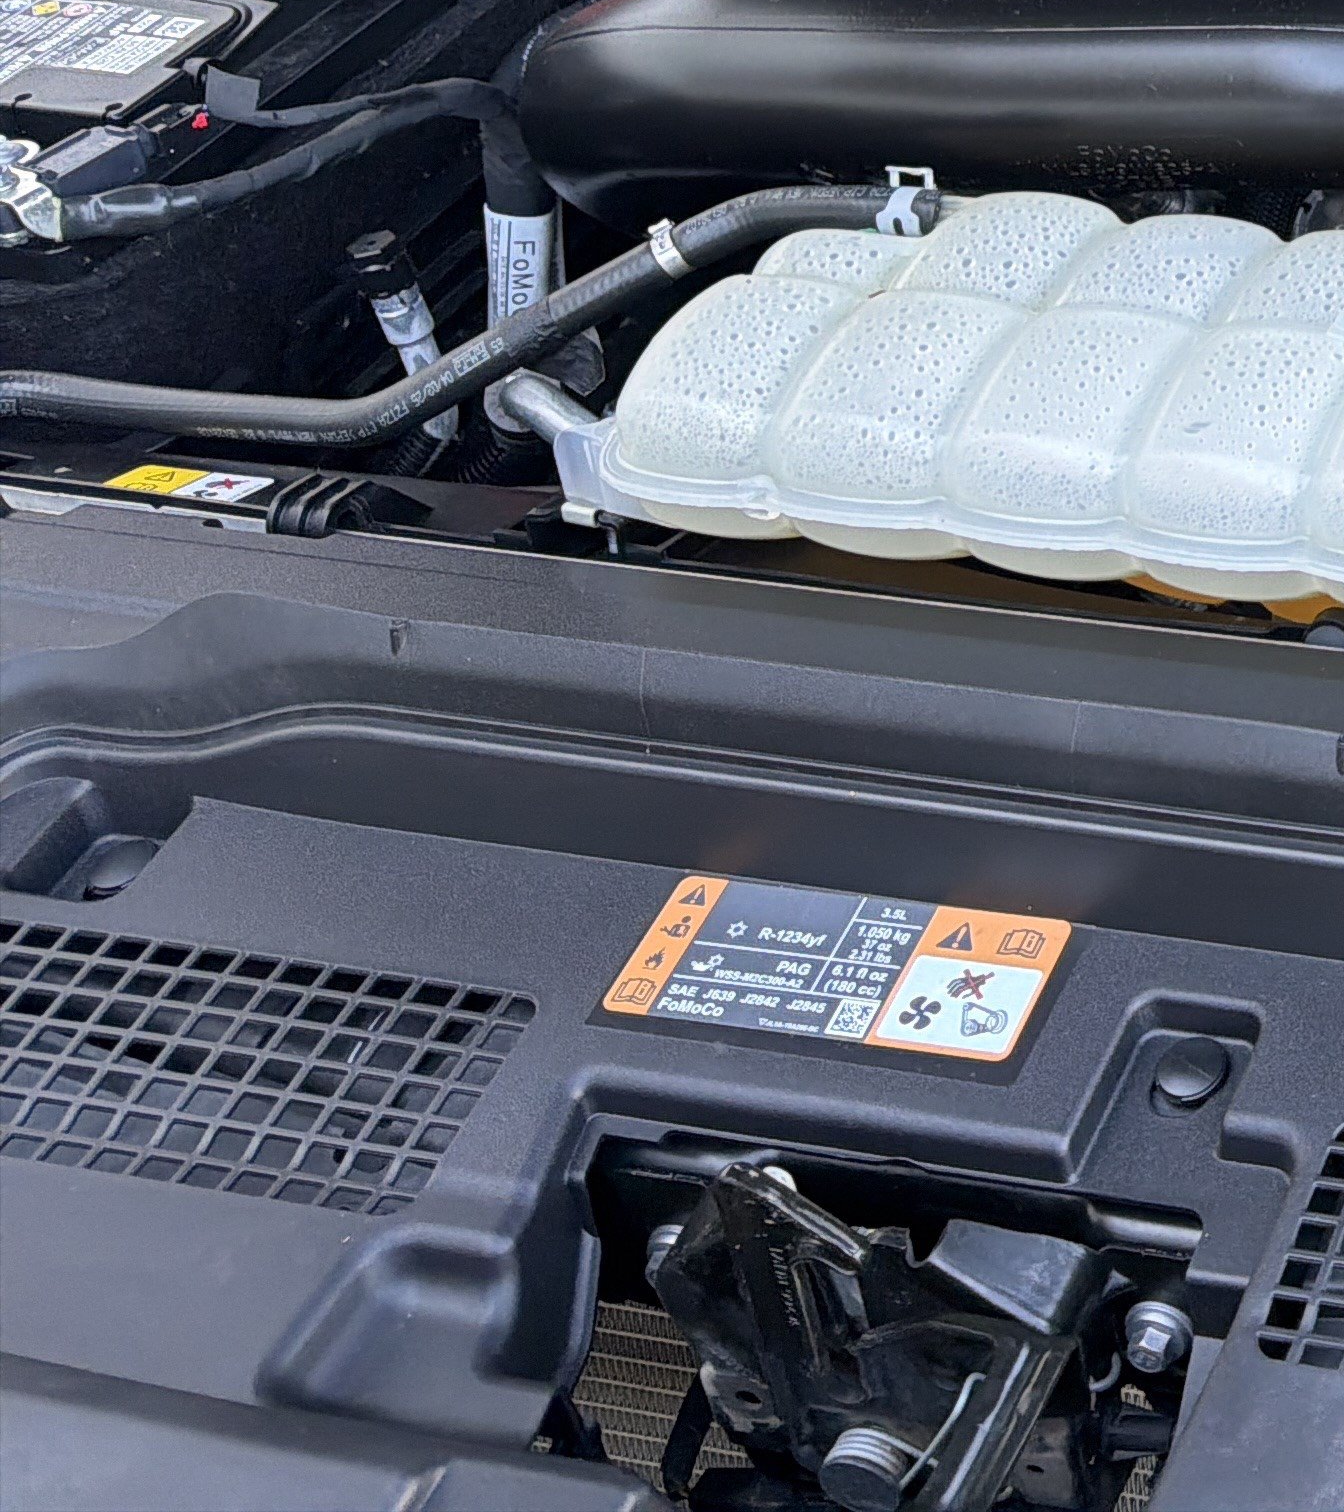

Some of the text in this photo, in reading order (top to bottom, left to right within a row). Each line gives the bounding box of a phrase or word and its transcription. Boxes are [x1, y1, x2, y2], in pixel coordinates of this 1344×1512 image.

[510, 240, 536, 315] FoMo
[880, 906, 908, 921] 3.5L
[757, 925, 828, 949] R-1234yf
[857, 924, 911, 946] 1.050 kg
[861, 938, 893, 953] 37 oz
[848, 947, 892, 965] 2.31 lbs
[776, 959, 811, 976] PAG
[831, 964, 889, 982] 6.1 fl oz
[667, 983, 827, 1015] SAE J639 J2842 J2845
[822, 978, 882, 999] (180 cc)
[656, 996, 724, 1018] FoMoCo
